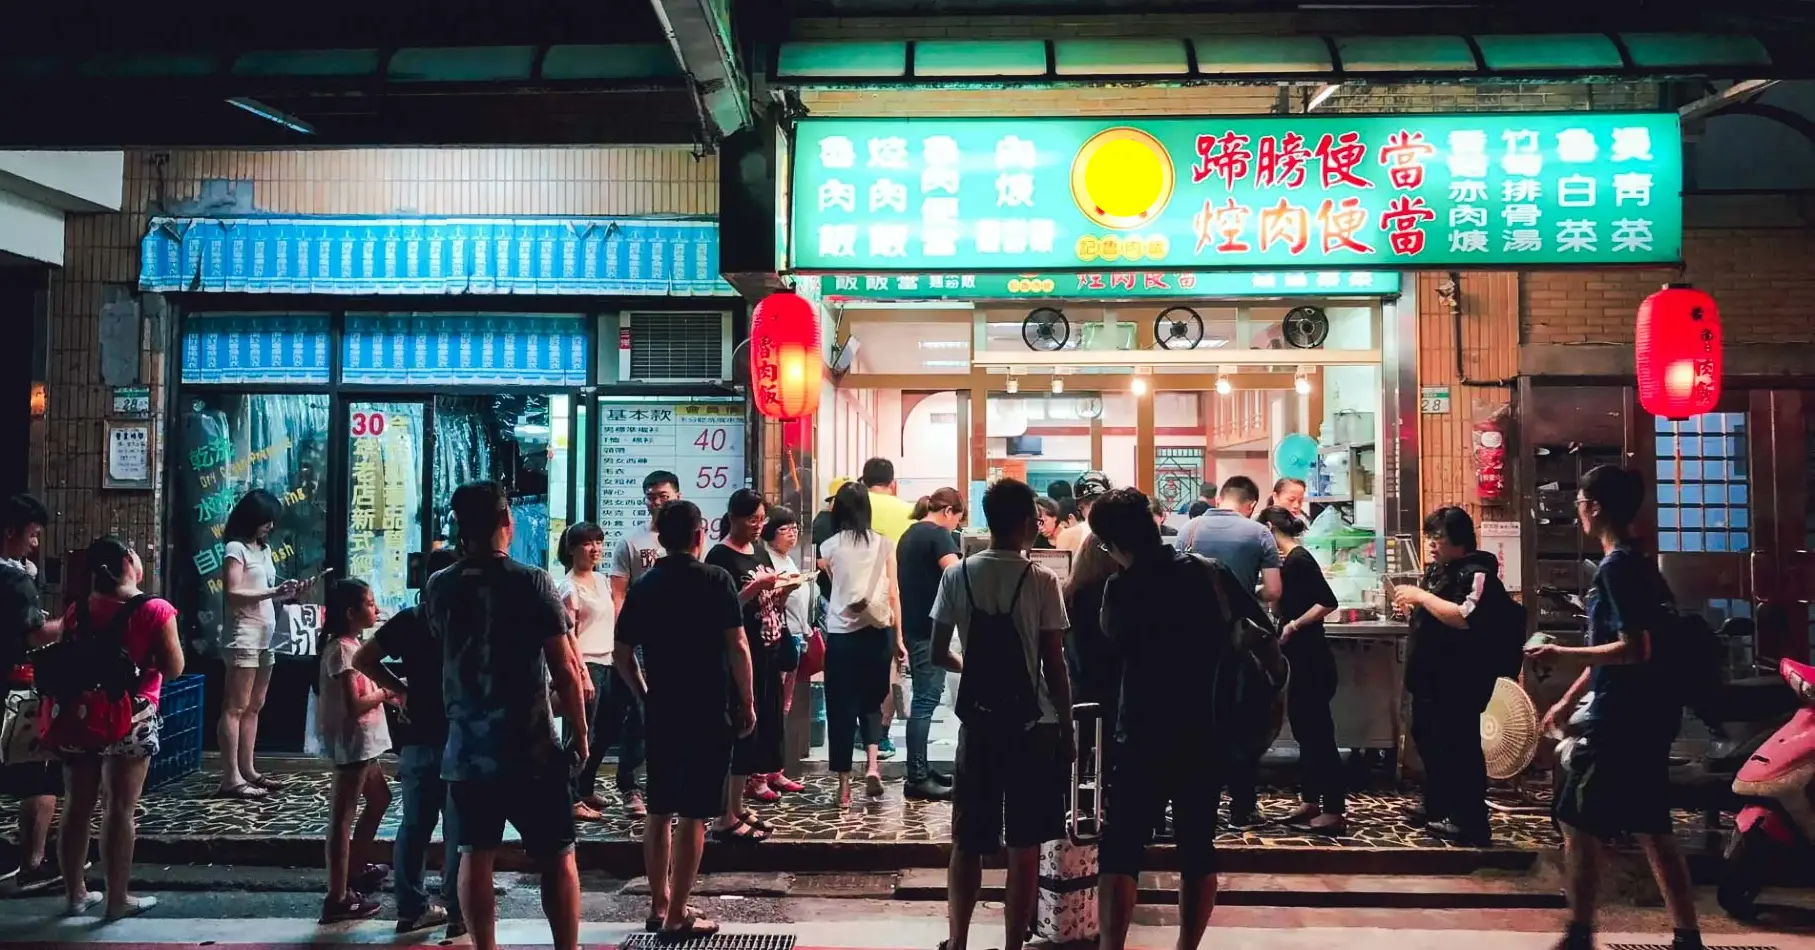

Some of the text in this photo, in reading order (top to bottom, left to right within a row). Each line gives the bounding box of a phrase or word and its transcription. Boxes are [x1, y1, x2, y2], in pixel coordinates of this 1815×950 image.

[1192, 131, 1434, 191] 蹄膀便當
[1446, 129, 1489, 252] 赤肉焿
[1501, 128, 1542, 252] 竹排骨湯
[1555, 127, 1599, 252] 白菜
[351, 413, 384, 436] 30
[606, 409, 672, 421] 基本款
[694, 428, 727, 452] 40
[696, 466, 729, 490] 55
